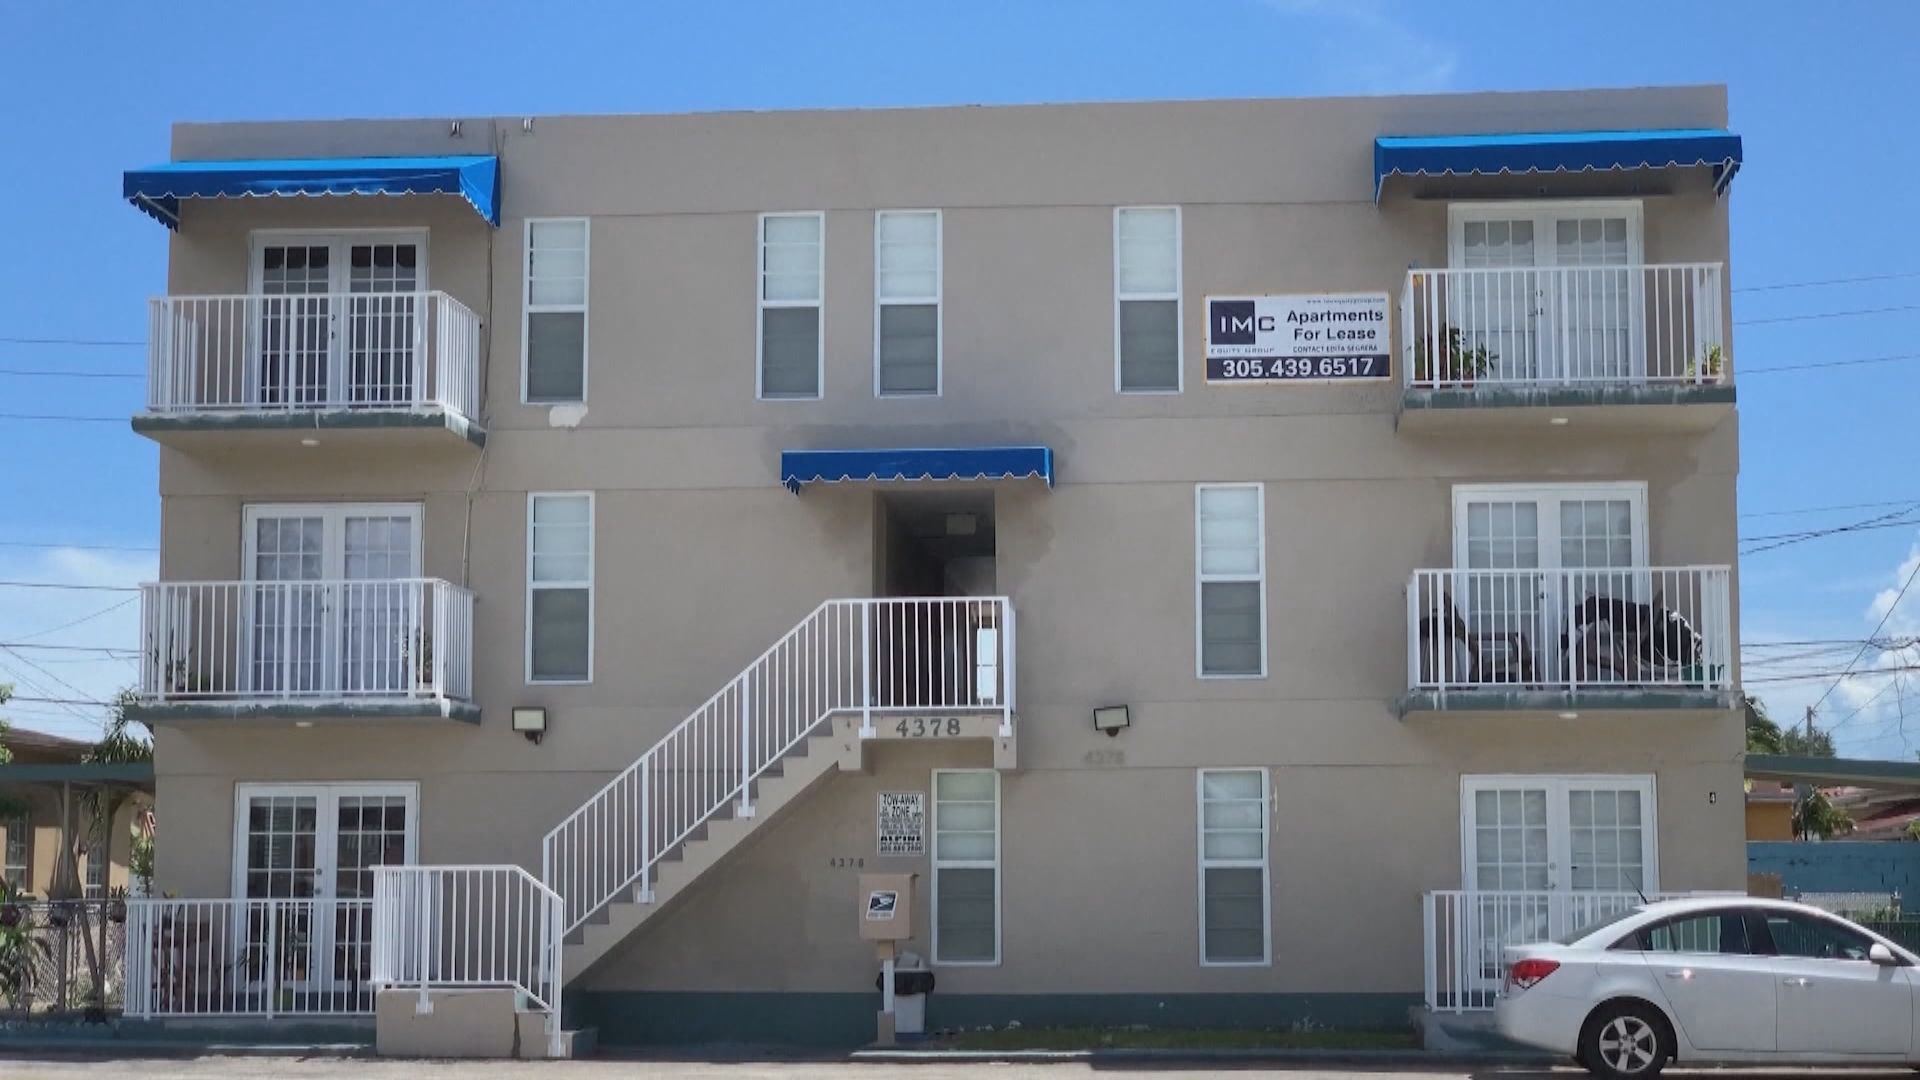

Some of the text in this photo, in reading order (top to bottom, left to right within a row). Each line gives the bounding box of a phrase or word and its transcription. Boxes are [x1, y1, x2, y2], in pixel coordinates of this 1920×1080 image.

[1221, 316, 1275, 333] IMC
[1287, 309, 1384, 325] Apartments
[1294, 327, 1376, 341] For Lease
[1223, 357, 1374, 377] 305.439.6517
[896, 718, 960, 737] 4378
[883, 794, 919, 806] TOW-AWAY
[892, 806, 910, 817] ZONE
[831, 857, 864, 868] 4378
